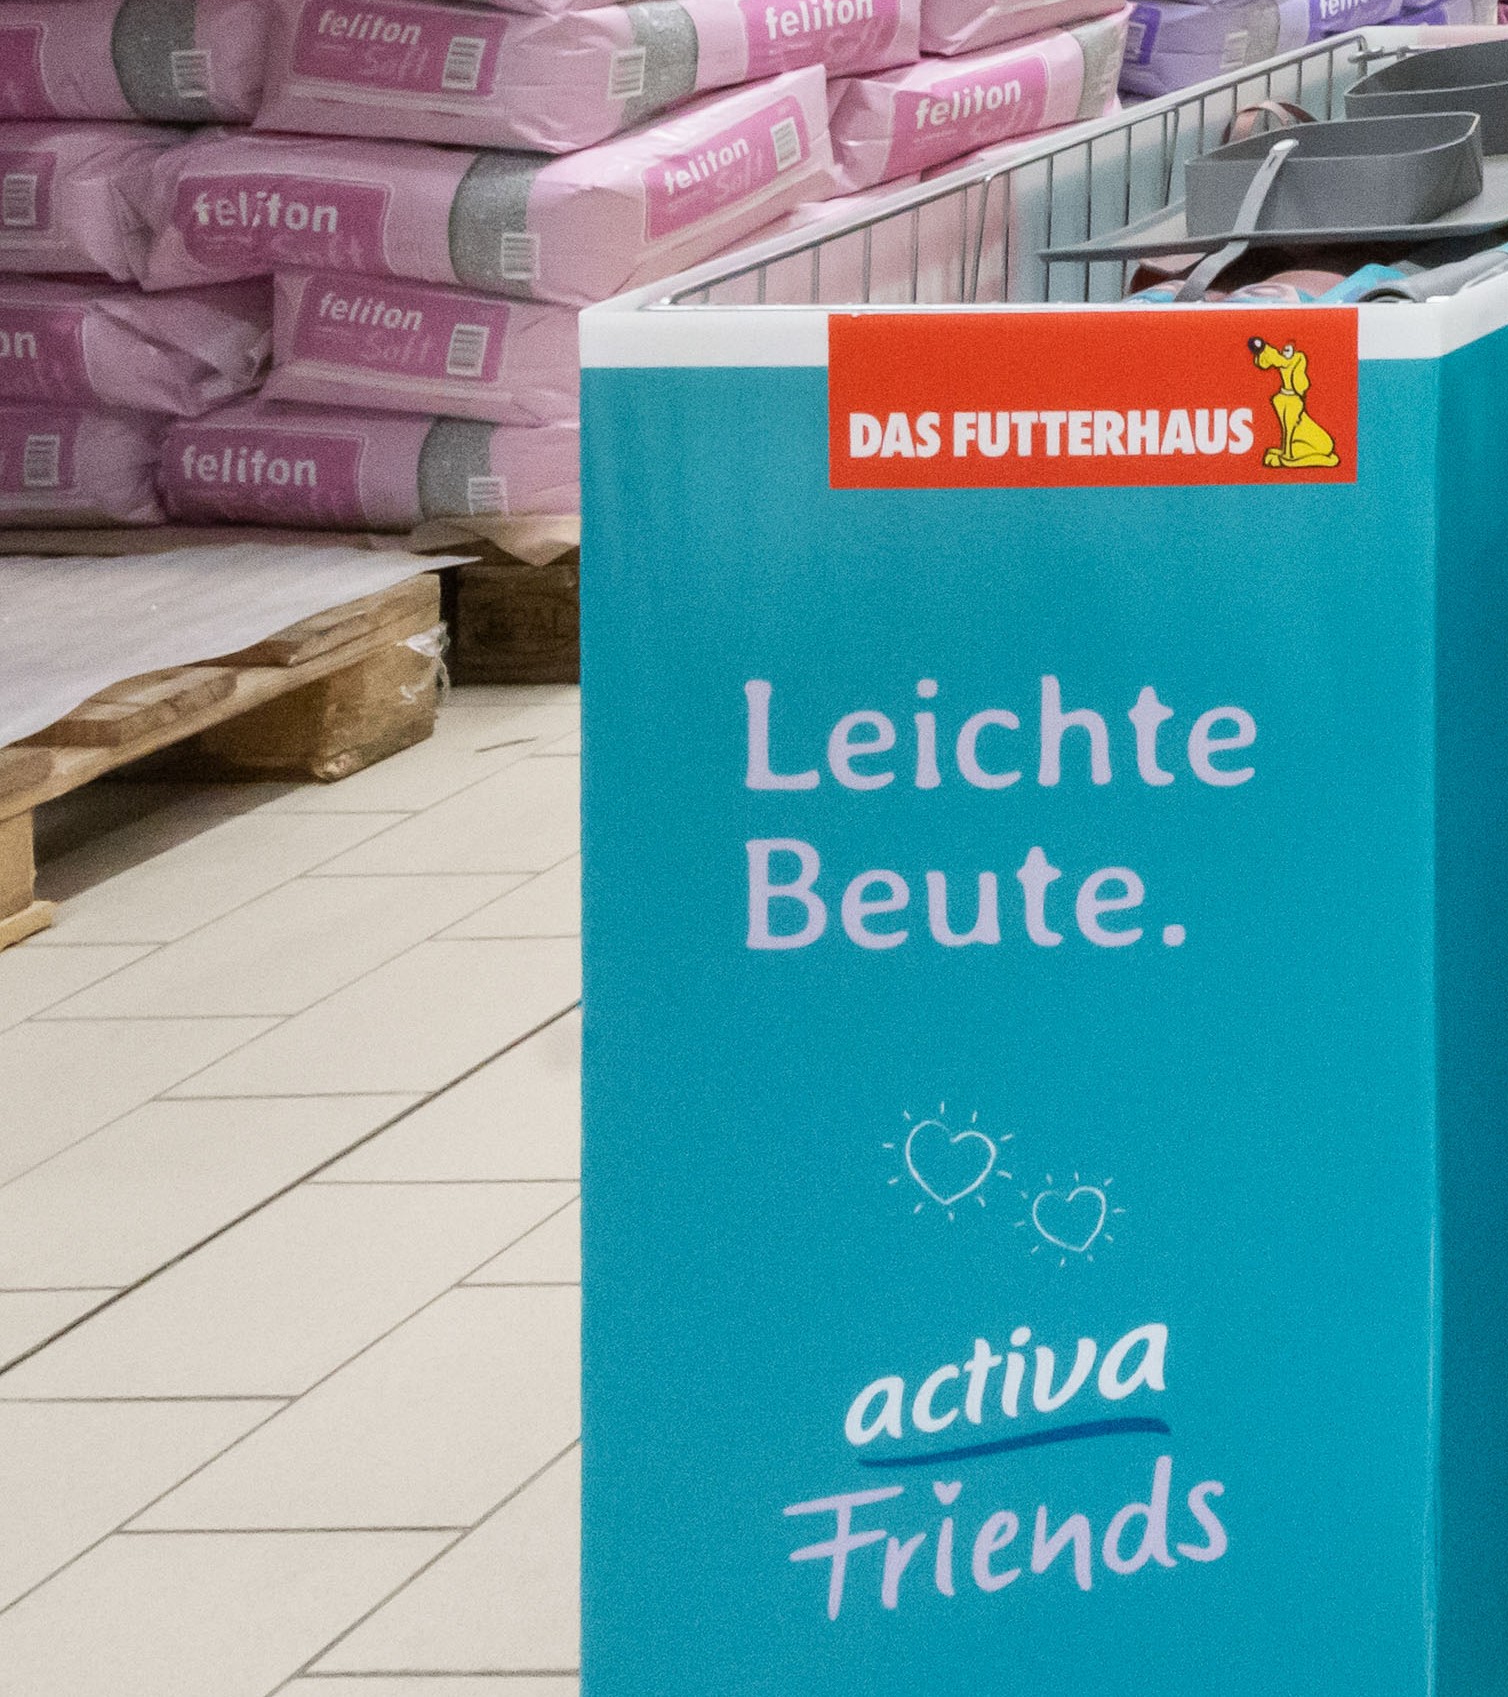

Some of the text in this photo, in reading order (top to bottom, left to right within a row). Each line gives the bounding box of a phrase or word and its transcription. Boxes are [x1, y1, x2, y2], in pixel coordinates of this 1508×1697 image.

[915, 79, 1022, 129] feliton
[849, 408, 1254, 459] DAS FUTTERHAUS
[744, 675, 1258, 790] Leichte
[745, 837, 1187, 950] Beute.
[844, 1322, 1169, 1446] activa
[783, 1454, 1228, 1620] Friends
